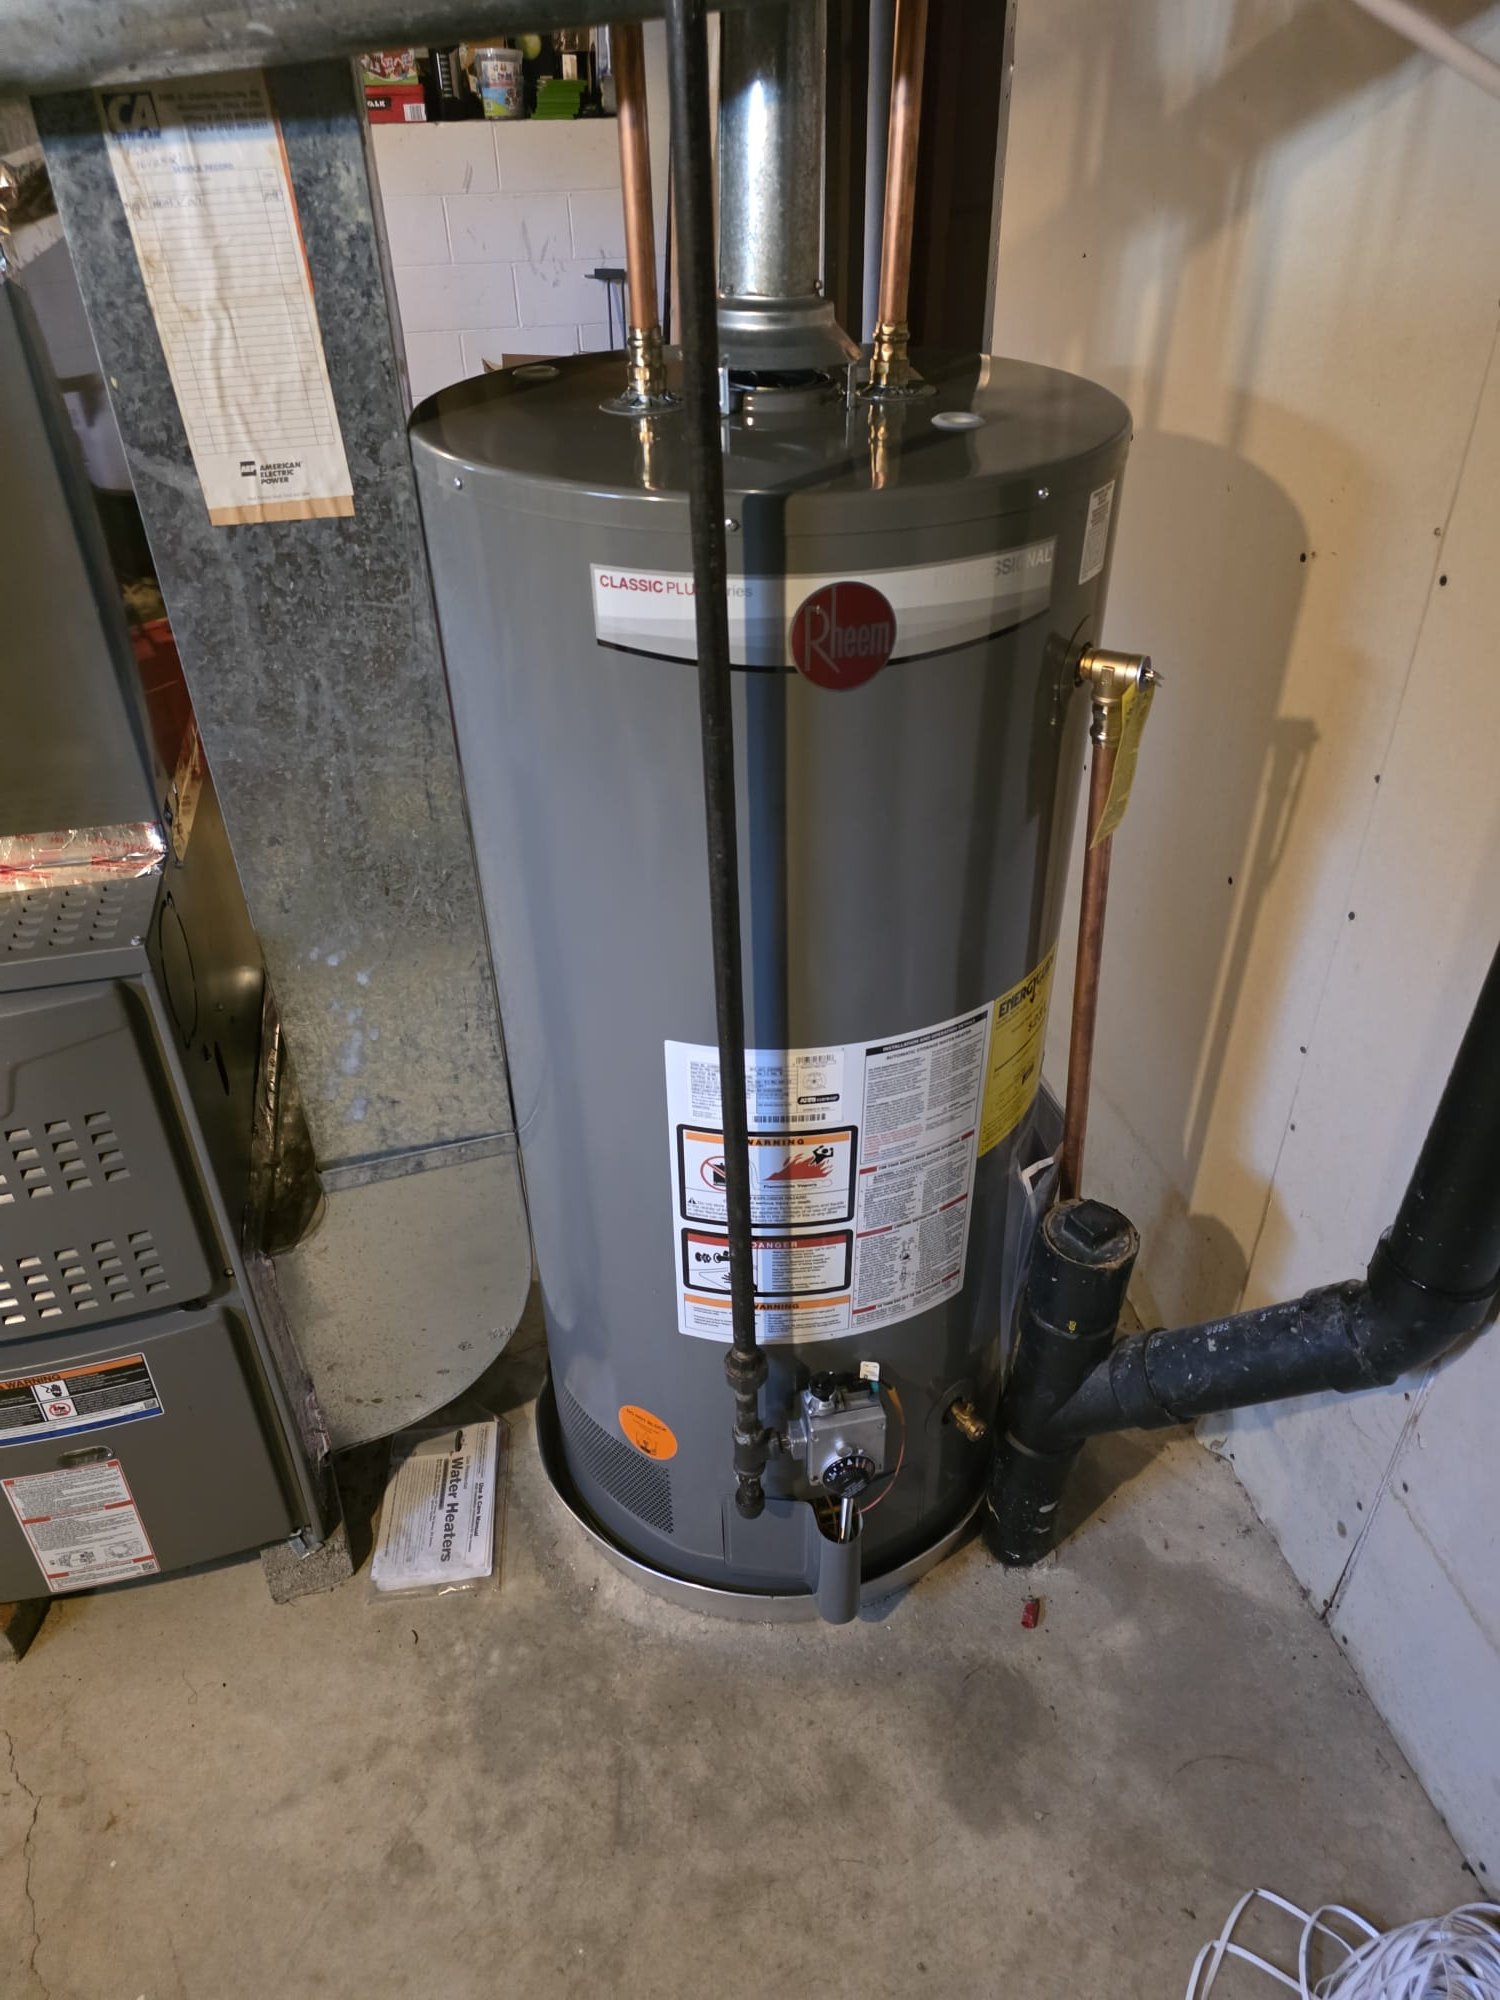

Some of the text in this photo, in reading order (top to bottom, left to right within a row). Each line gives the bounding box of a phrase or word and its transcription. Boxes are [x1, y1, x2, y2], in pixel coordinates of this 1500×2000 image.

[260, 461, 301, 471] AMERICAN
[260, 469, 294, 478] ELECTRIC
[260, 476, 289, 485] POWER
[600, 575, 663, 593] CLASSIC
[666, 581, 698, 596] PLU
[804, 584, 890, 673] Rheem
[5, 1374, 61, 1388] WARNING
[447, 1457, 464, 1498] Water
[440, 1502, 459, 1563] Heaters
